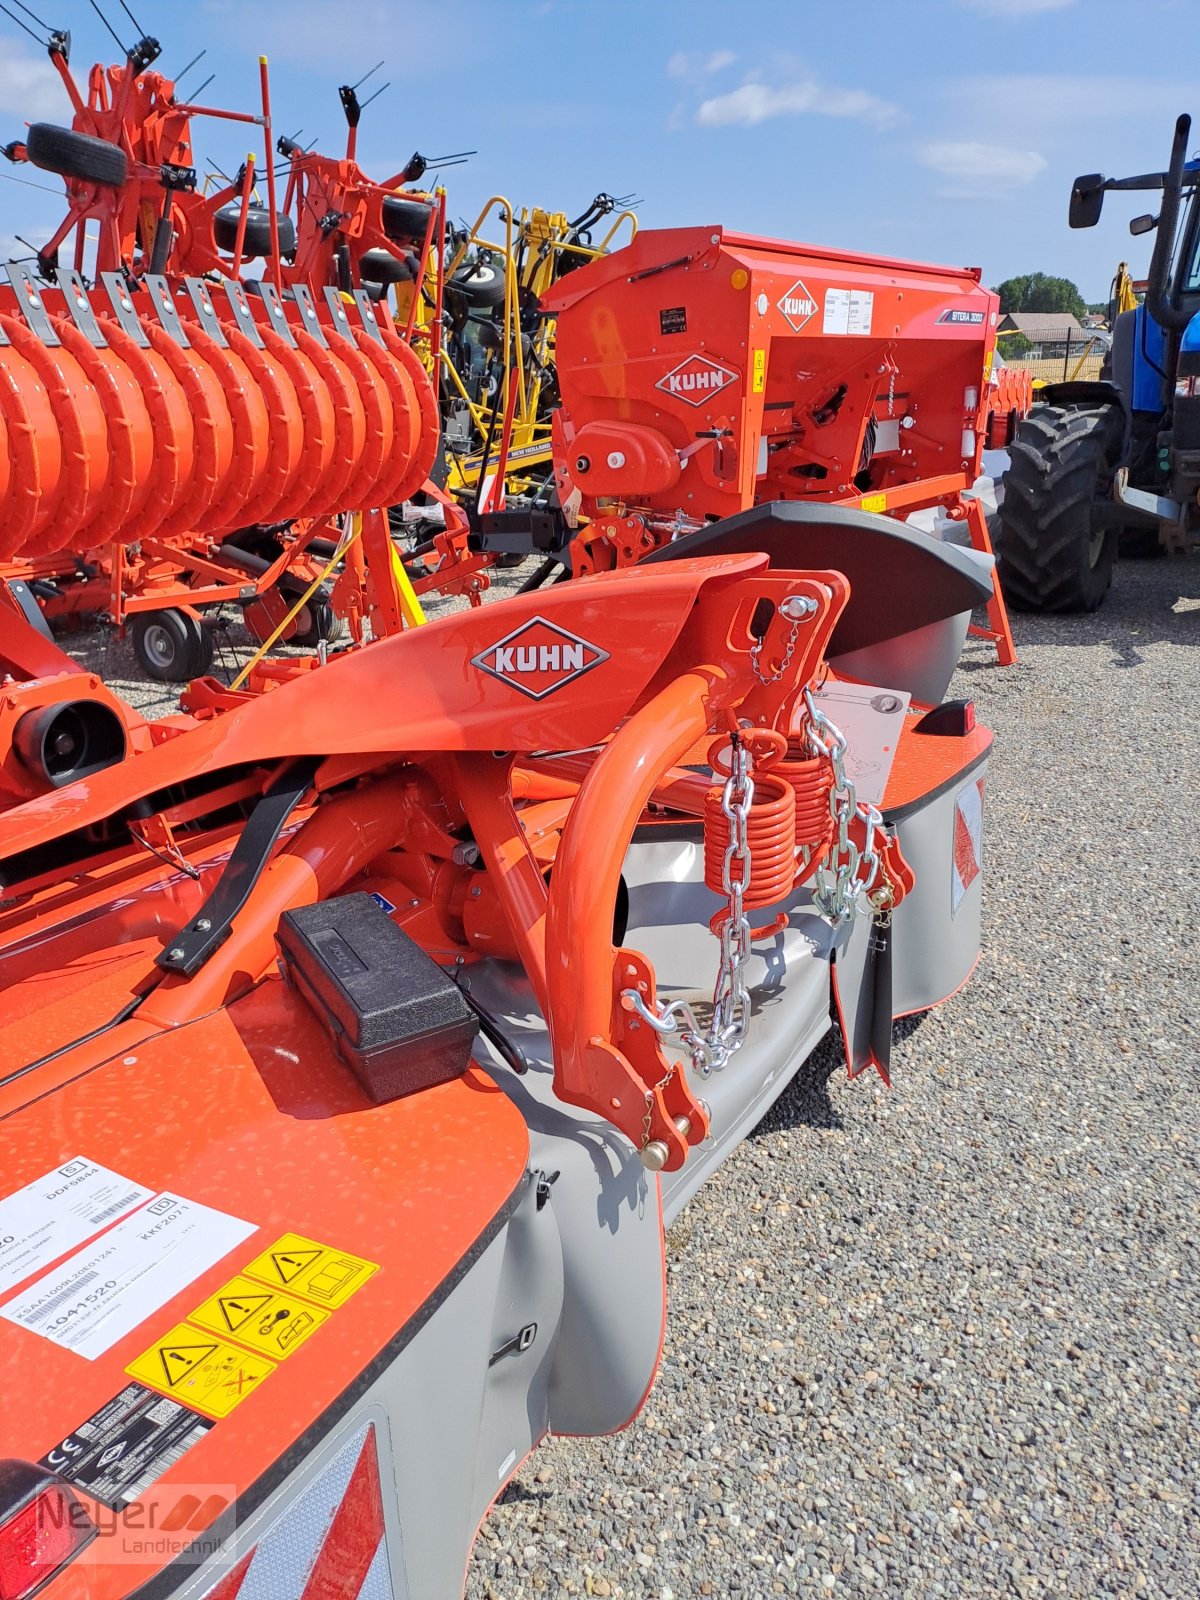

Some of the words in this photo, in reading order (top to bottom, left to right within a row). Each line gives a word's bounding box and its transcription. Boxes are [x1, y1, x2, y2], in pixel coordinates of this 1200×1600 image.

[785, 298, 812, 316] KUHN
[952, 311, 969, 322] SITERA
[970, 312, 983, 323] 3000
[669, 370, 723, 393] KUHN
[511, 449, 525, 457] NEW
[525, 442, 551, 454] HOLLAND
[495, 643, 584, 673] KUHN
[65, 1166, 77, 1174] S
[46, 1168, 99, 1200] DDF5844
[152, 1199, 172, 1211] ID
[139, 1204, 191, 1240] KKF2071
[44, 1278, 119, 1333] 1041520
